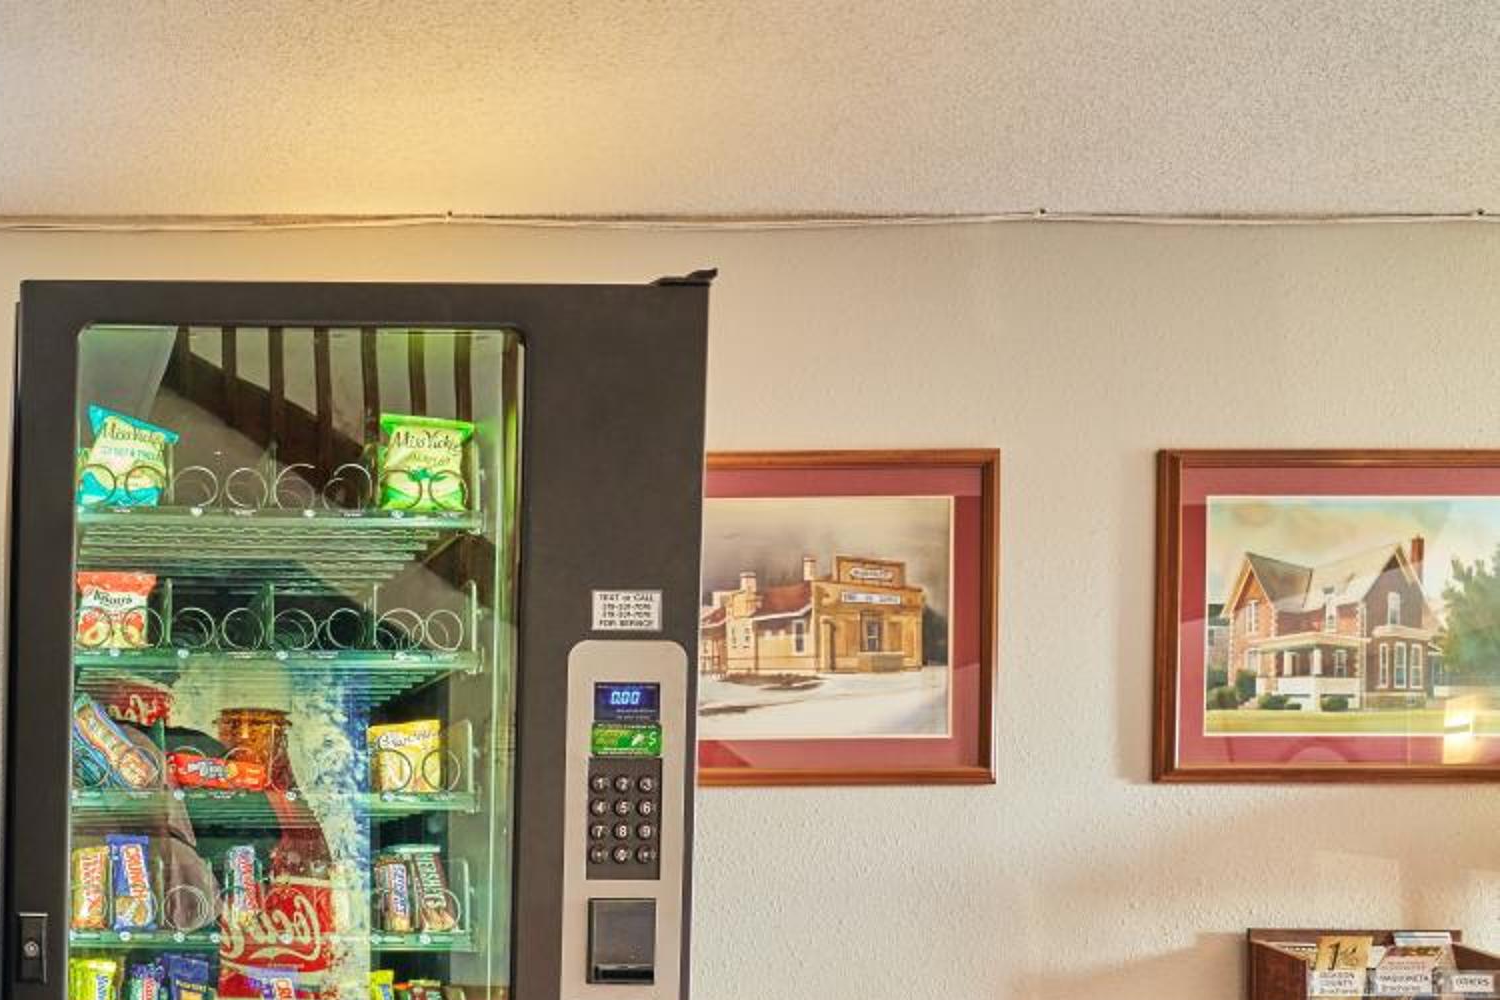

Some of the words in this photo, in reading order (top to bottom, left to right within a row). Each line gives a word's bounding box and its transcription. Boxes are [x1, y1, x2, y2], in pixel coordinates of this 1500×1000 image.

[621, 801, 628, 814] 5
[643, 801, 651, 814] 6
[595, 825, 604, 838] 7
[620, 825, 627, 837] 8
[643, 825, 651, 837] 9
[122, 846, 150, 902] CRUNCH
[1454, 977, 1491, 987] OTHERS
